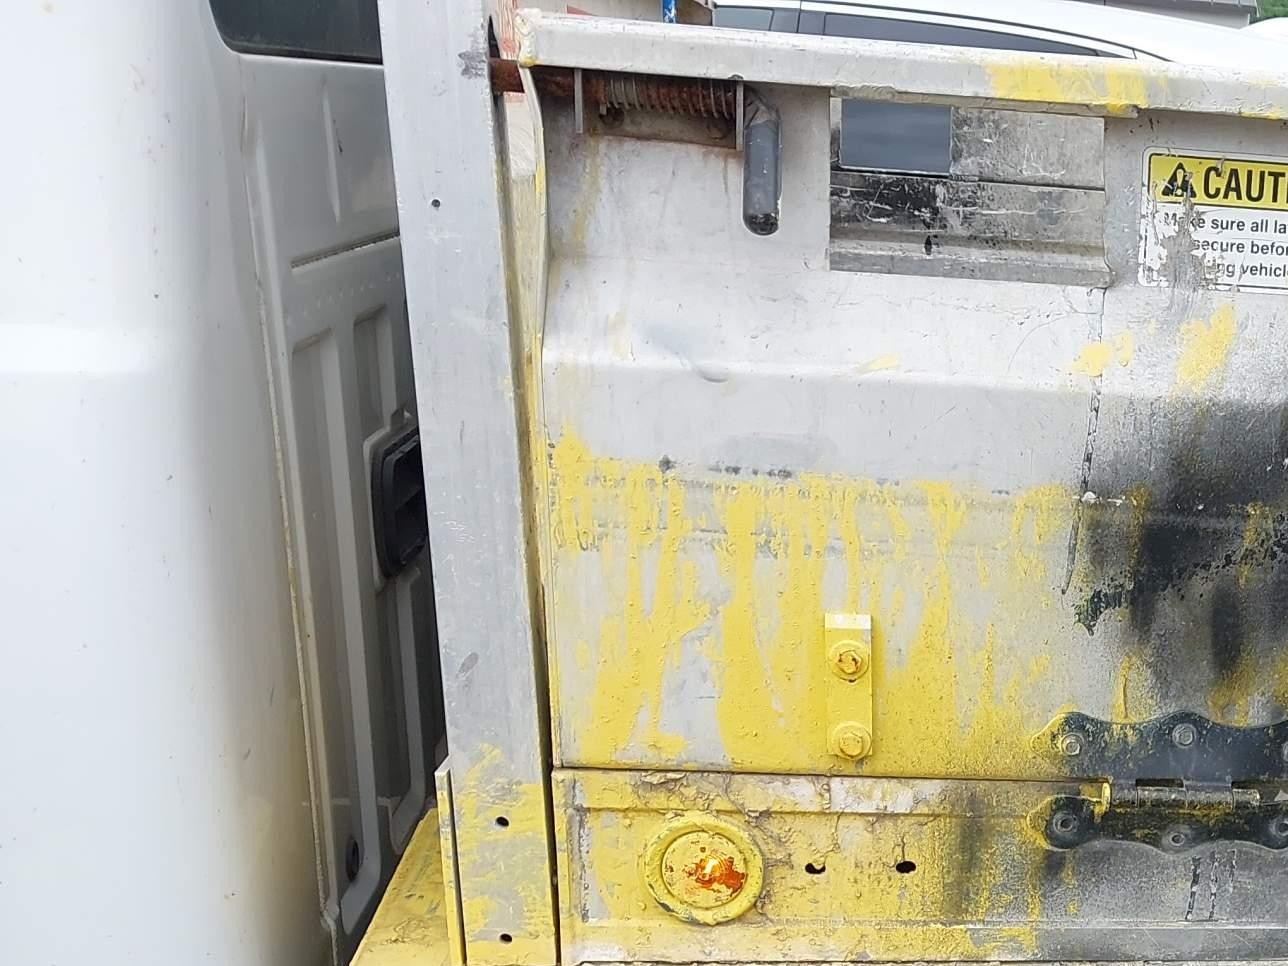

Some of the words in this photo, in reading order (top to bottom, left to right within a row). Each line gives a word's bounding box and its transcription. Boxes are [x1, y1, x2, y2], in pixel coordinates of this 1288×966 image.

[1210, 217, 1246, 232] sure
[1250, 218, 1269, 233] all
[1193, 238, 1245, 254] secure
